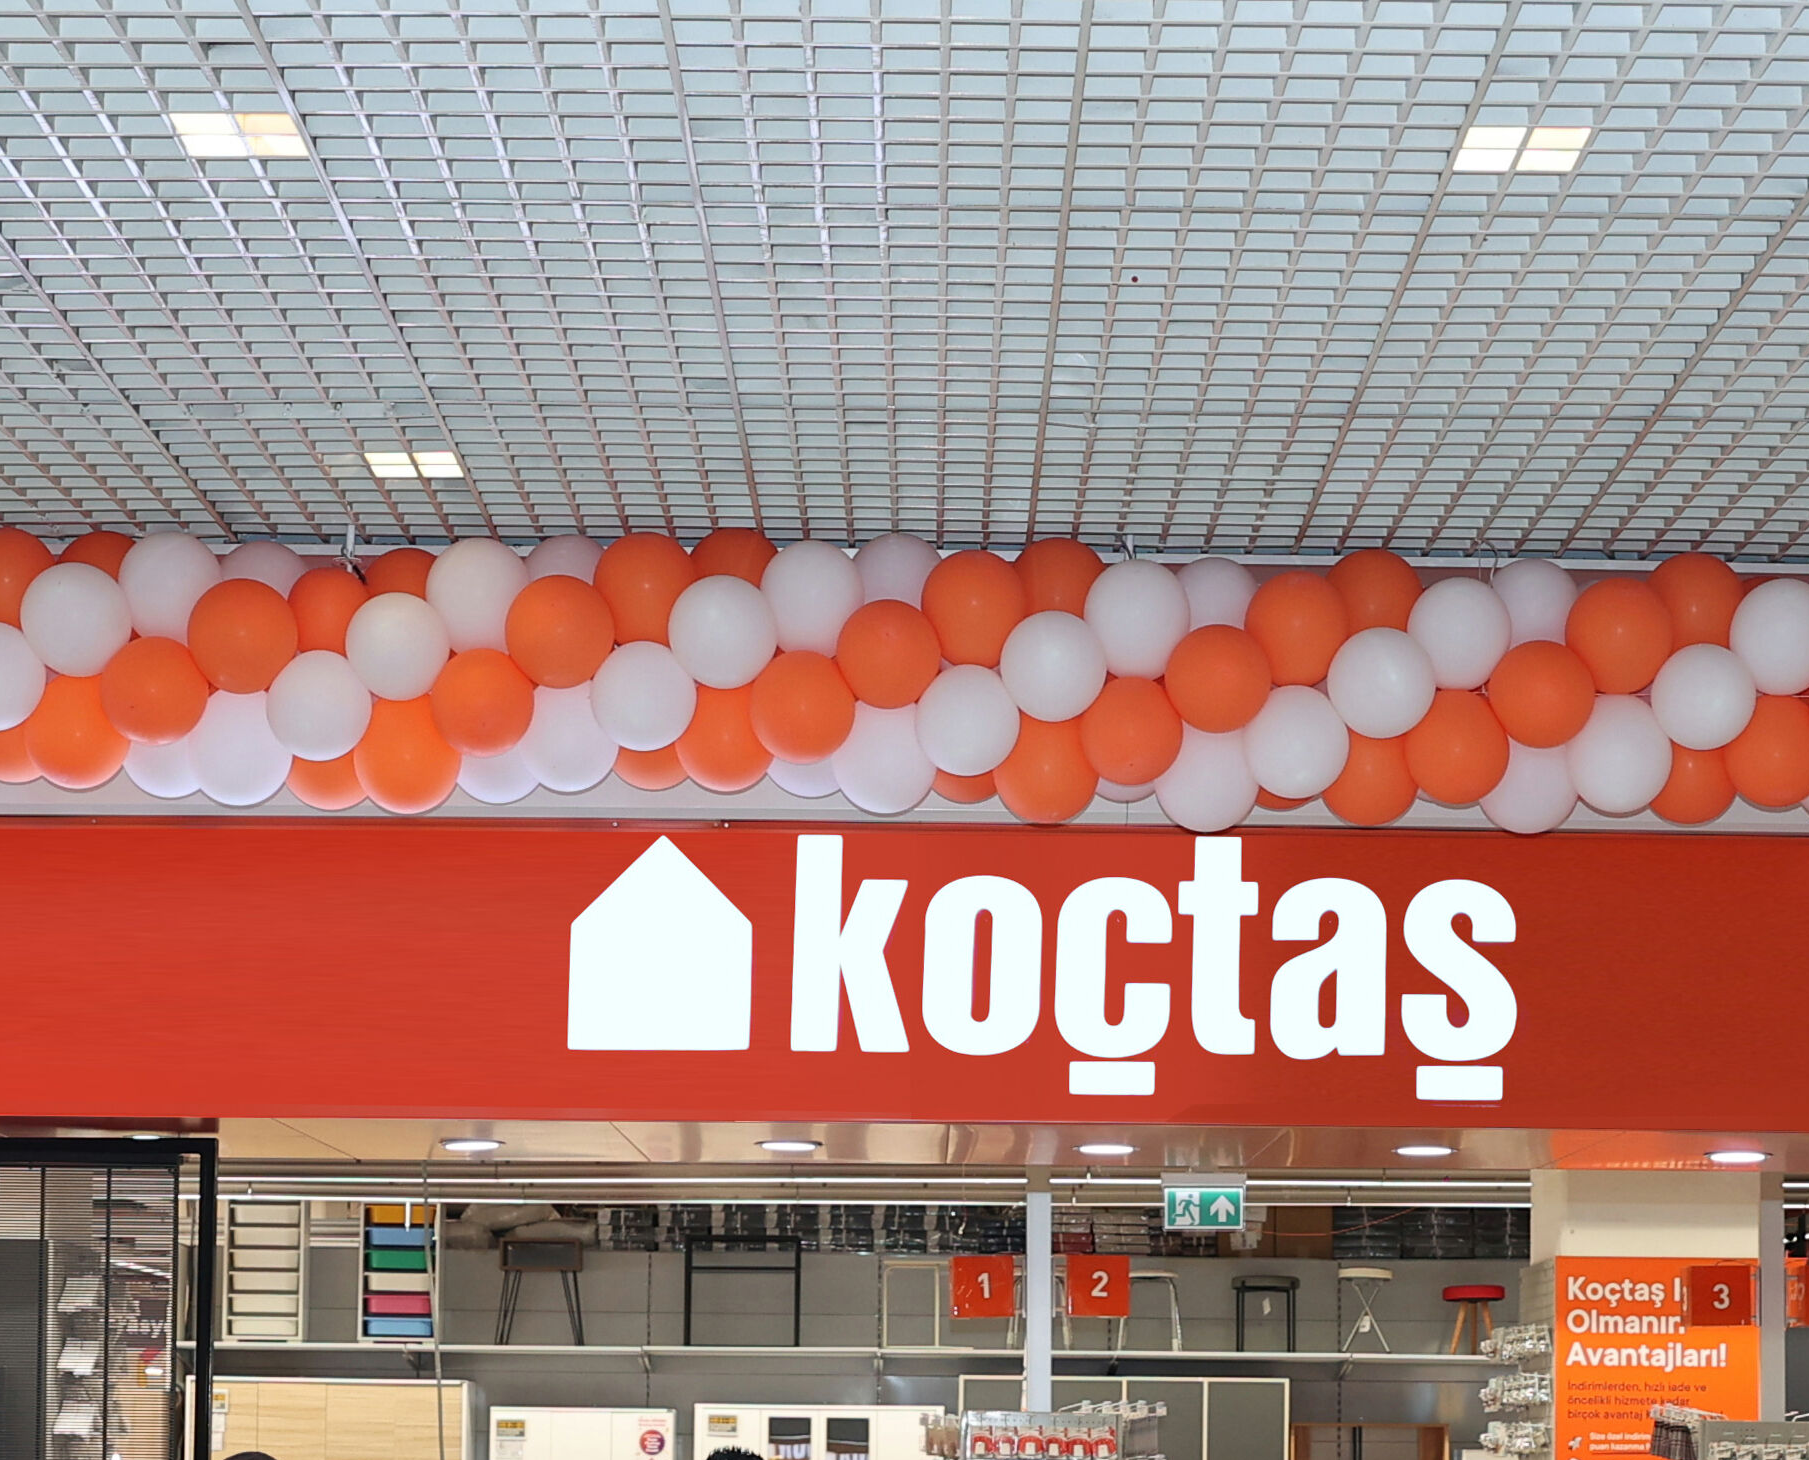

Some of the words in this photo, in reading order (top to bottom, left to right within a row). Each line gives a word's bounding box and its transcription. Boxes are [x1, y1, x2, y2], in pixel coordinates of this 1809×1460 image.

[790, 834, 1518, 1101] koçtaş
[977, 1272, 990, 1299] 1
[1091, 1270, 1109, 1297] 2
[1567, 1276, 1665, 1308] Koçtaş
[1712, 1283, 1730, 1310] 3
[1565, 1341, 1727, 1373] Avantajları!
[1694, 1384, 1707, 1392] ve
